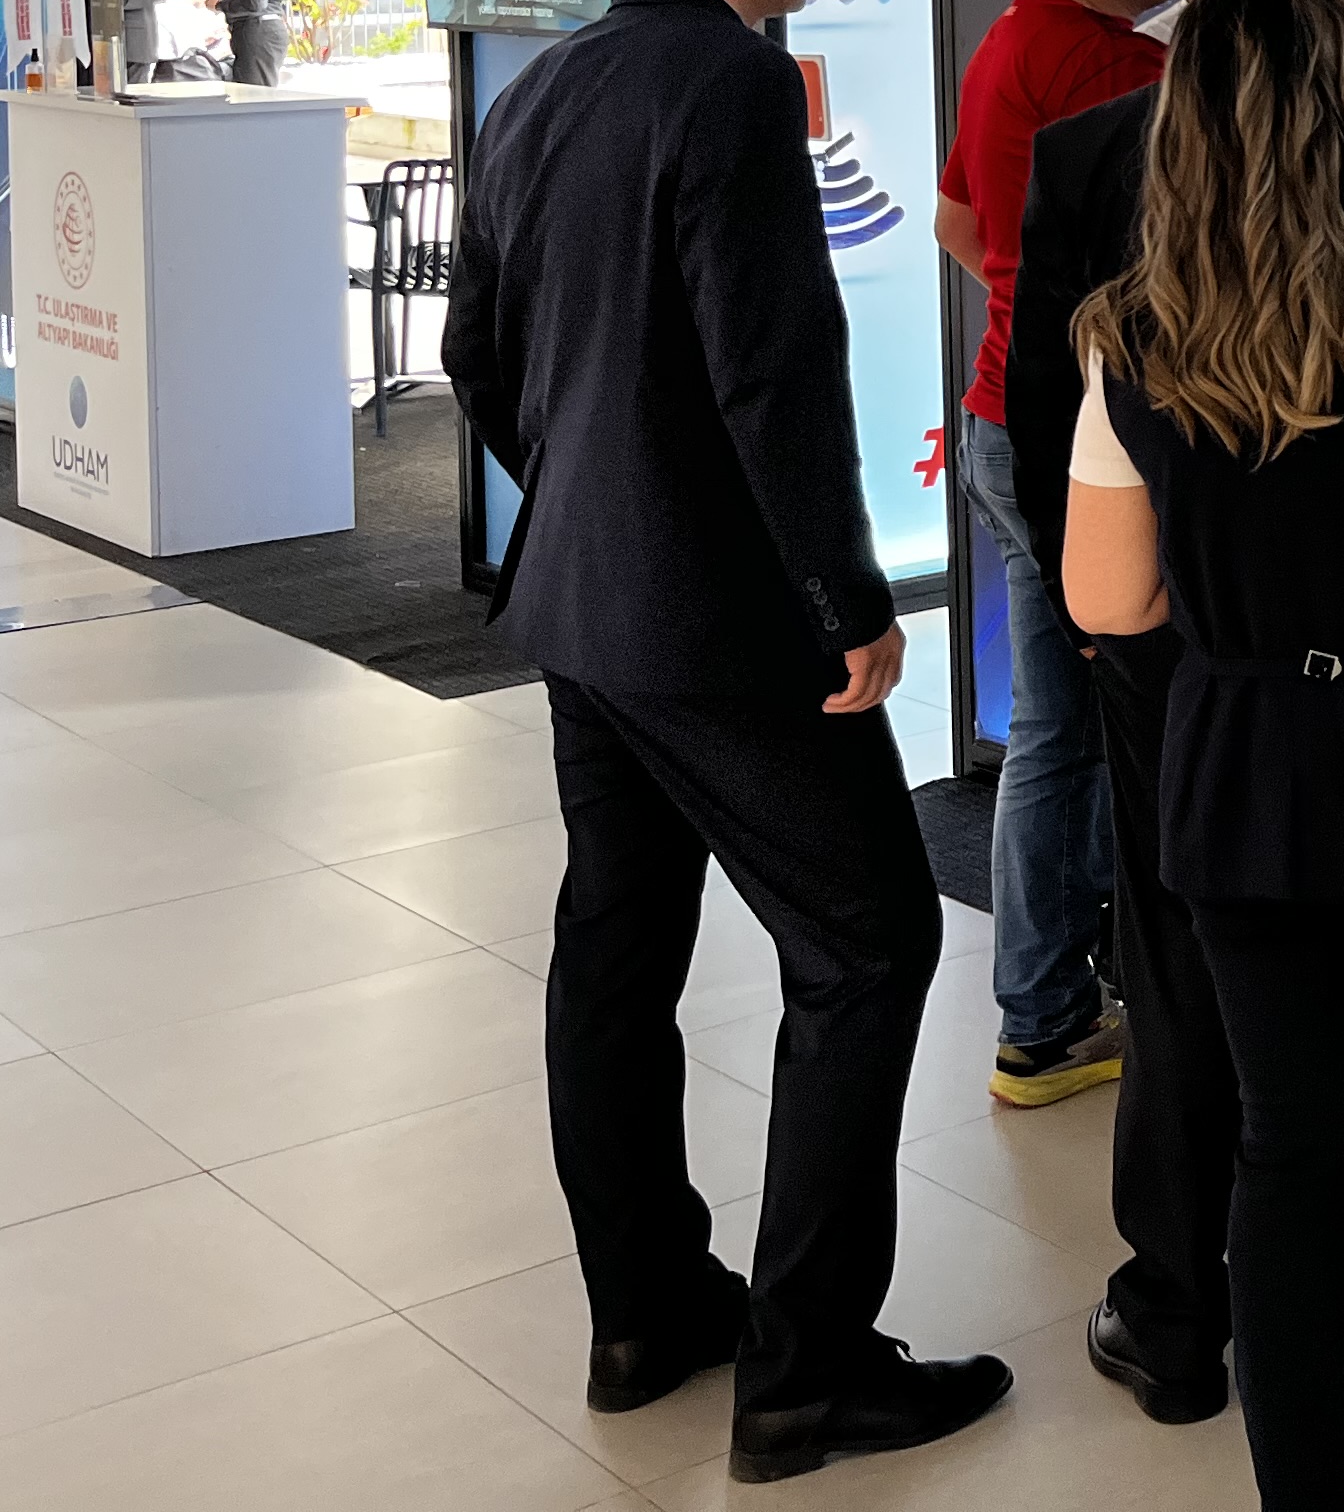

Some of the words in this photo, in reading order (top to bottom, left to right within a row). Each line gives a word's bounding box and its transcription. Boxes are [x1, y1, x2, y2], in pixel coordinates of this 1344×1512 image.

[36, 294, 51, 316] T.C.
[53, 299, 104, 328] ULAŞTIRMA
[106, 311, 119, 333] VE
[37, 321, 71, 346] ALTYAPI
[72, 332, 119, 361] BAKANLIĞI
[52, 435, 109, 486] UDHAM
